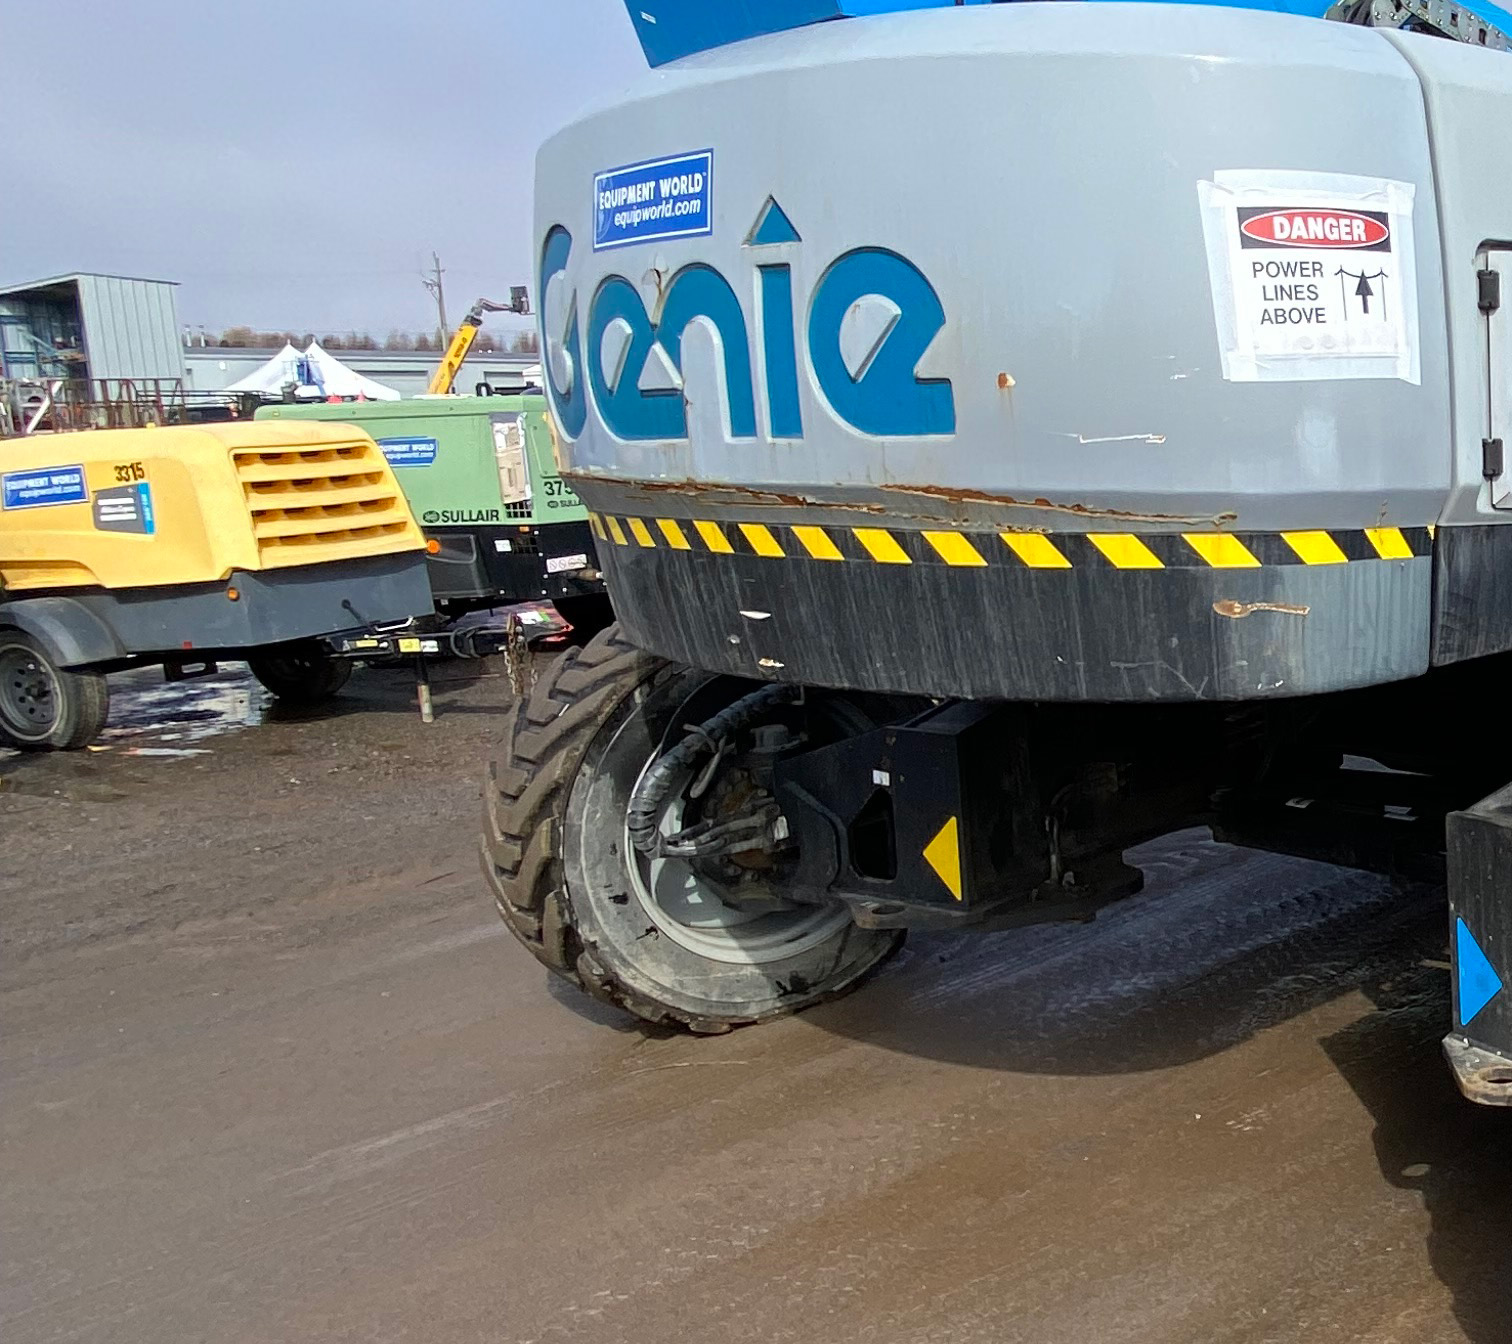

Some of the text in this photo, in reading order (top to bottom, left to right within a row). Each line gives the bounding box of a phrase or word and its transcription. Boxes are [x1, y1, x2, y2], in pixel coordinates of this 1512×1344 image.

[600, 173, 703, 209] EQUIPMENT WORLD
[615, 199, 701, 229] equipworld.com
[1273, 216, 1367, 242] DANGER
[1252, 261, 1324, 278] POWER
[1262, 284, 1319, 301] LINES
[541, 194, 956, 442] Genie
[1260, 308, 1327, 325] ABOVE
[114, 462, 145, 481] 3315
[441, 509, 500, 523] SULLAIR
